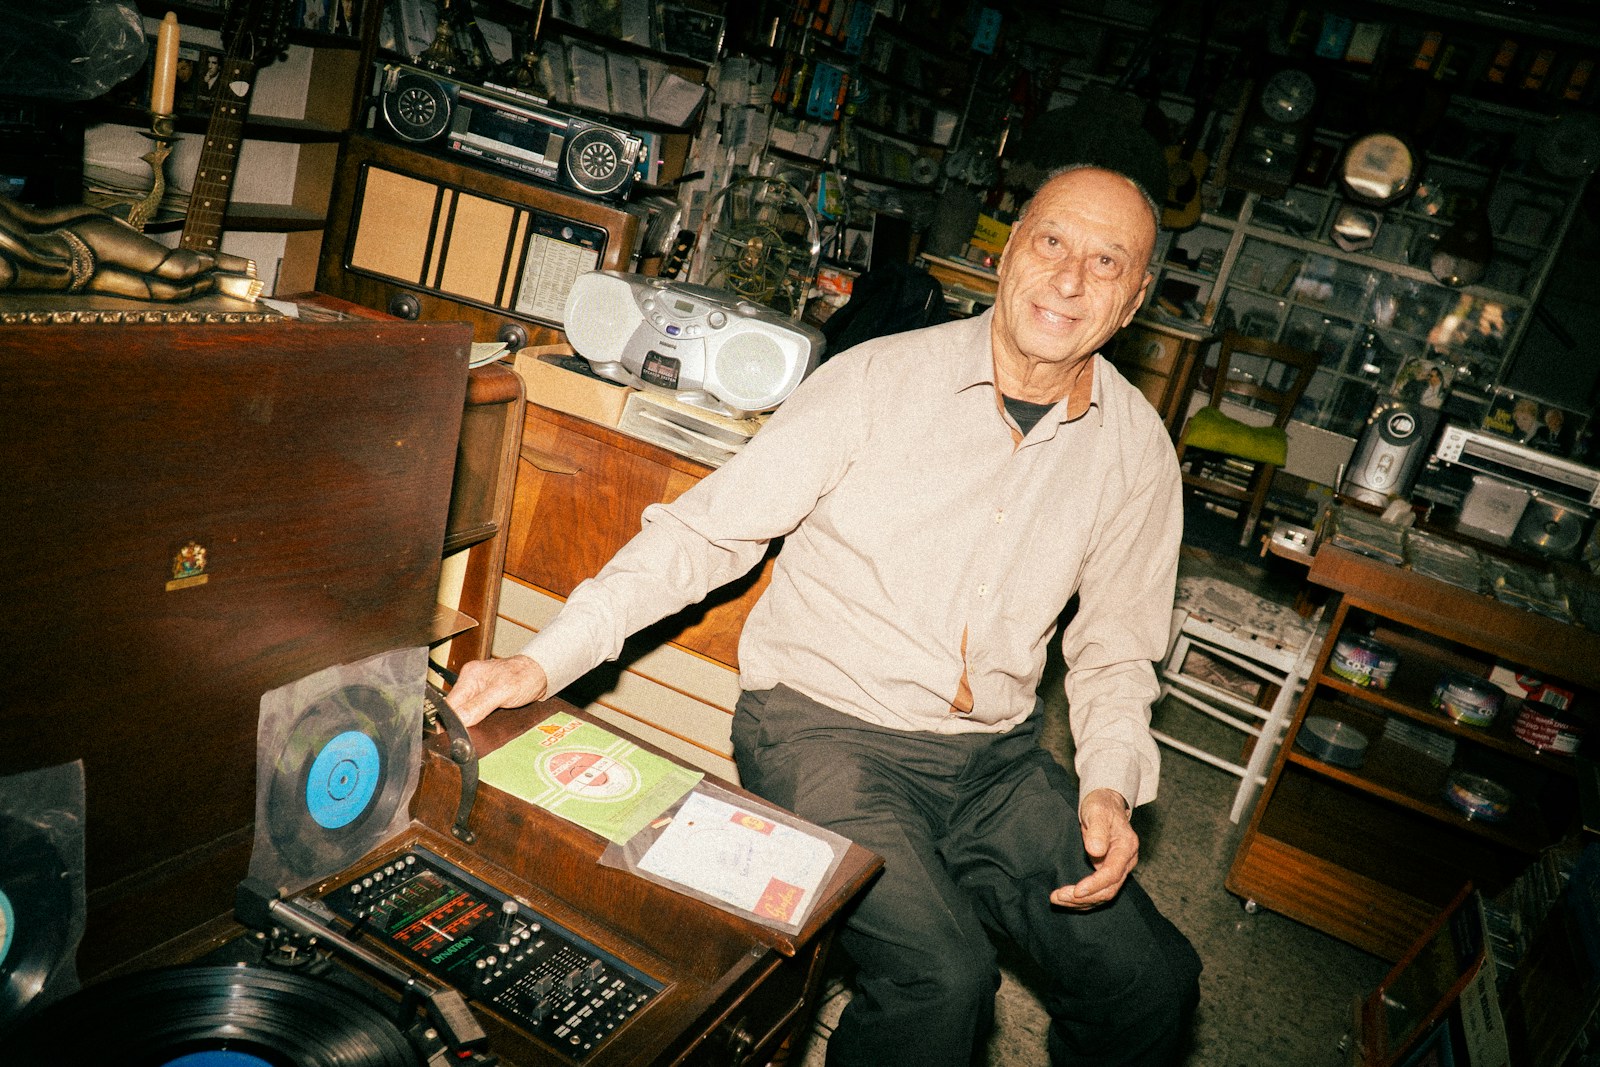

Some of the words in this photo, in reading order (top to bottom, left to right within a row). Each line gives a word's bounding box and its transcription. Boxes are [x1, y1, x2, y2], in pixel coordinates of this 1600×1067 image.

[460, 144, 483, 156] National
[1345, 659, 1373, 676] CD-R
[431, 935, 475, 965] DYNATRON
